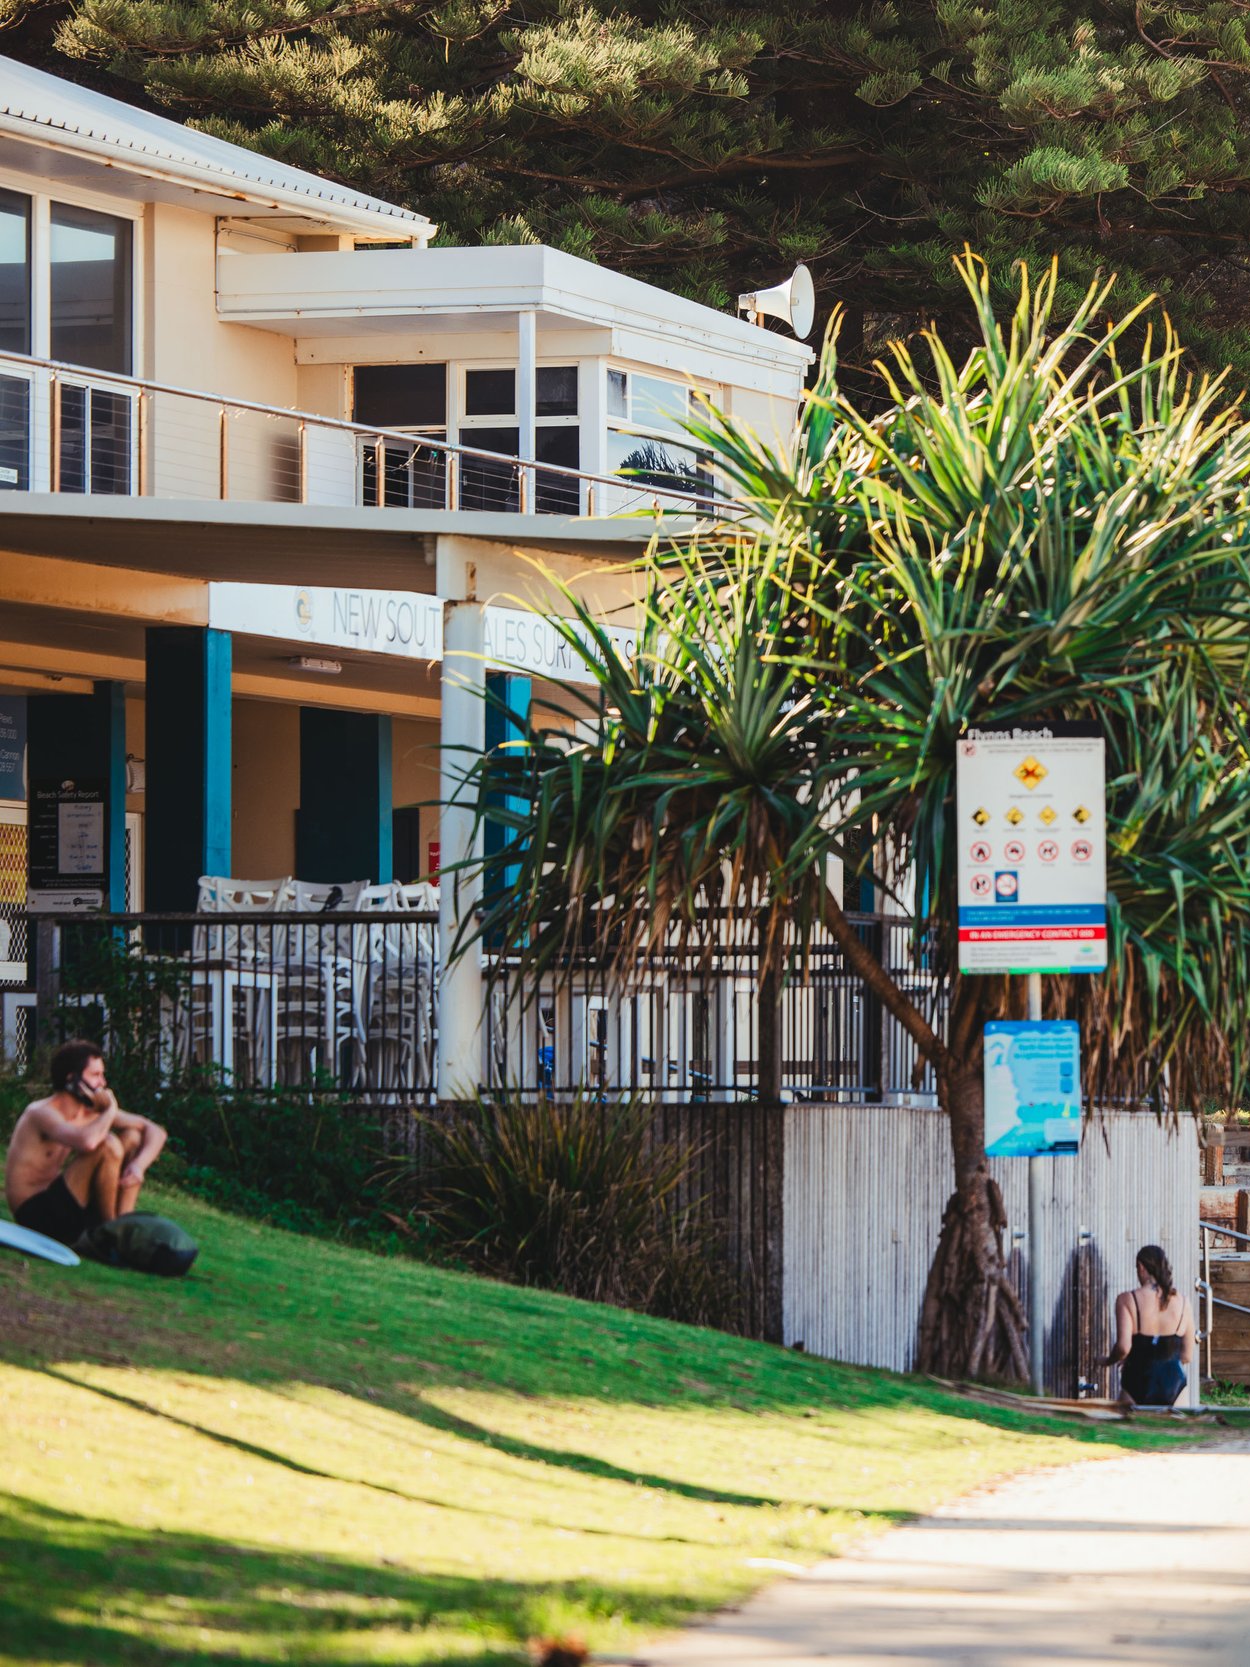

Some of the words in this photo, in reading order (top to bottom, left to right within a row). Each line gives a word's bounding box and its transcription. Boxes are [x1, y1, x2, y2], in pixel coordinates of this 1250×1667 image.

[333, 591, 382, 639] NEW
[386, 599, 441, 649] SOUT
[483, 615, 527, 662] ALES
[1012, 726, 1054, 740] Beach
[37, 791, 57, 799] Beach
[57, 790, 77, 800] Safety
[78, 790, 99, 800] Report
[993, 929, 1041, 939] EMERGENCY
[1041, 928, 1079, 939] CONTACT
